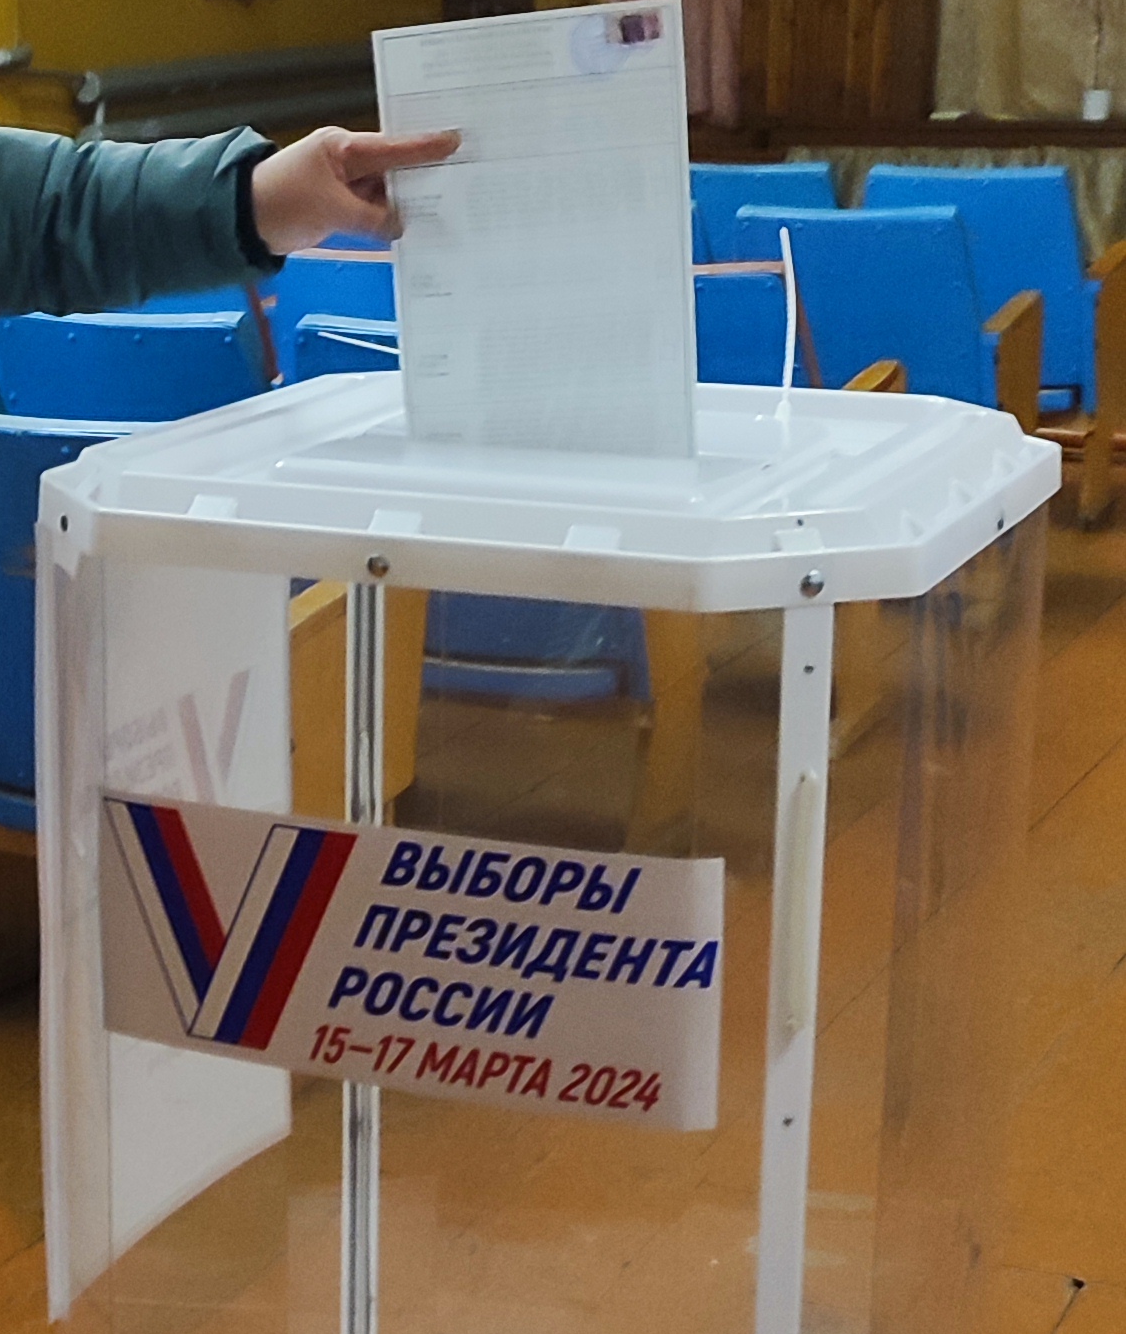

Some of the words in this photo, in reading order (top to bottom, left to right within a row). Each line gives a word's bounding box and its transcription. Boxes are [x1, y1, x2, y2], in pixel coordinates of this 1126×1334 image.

[381, 841, 642, 914] ВЫБОРЫ
[354, 906, 720, 990] ПРЕЗИДЕНТА
[328, 966, 555, 1039] РОССИИ
[419, 1042, 552, 1100] МАРТА
[558, 1063, 661, 1113] 2024
